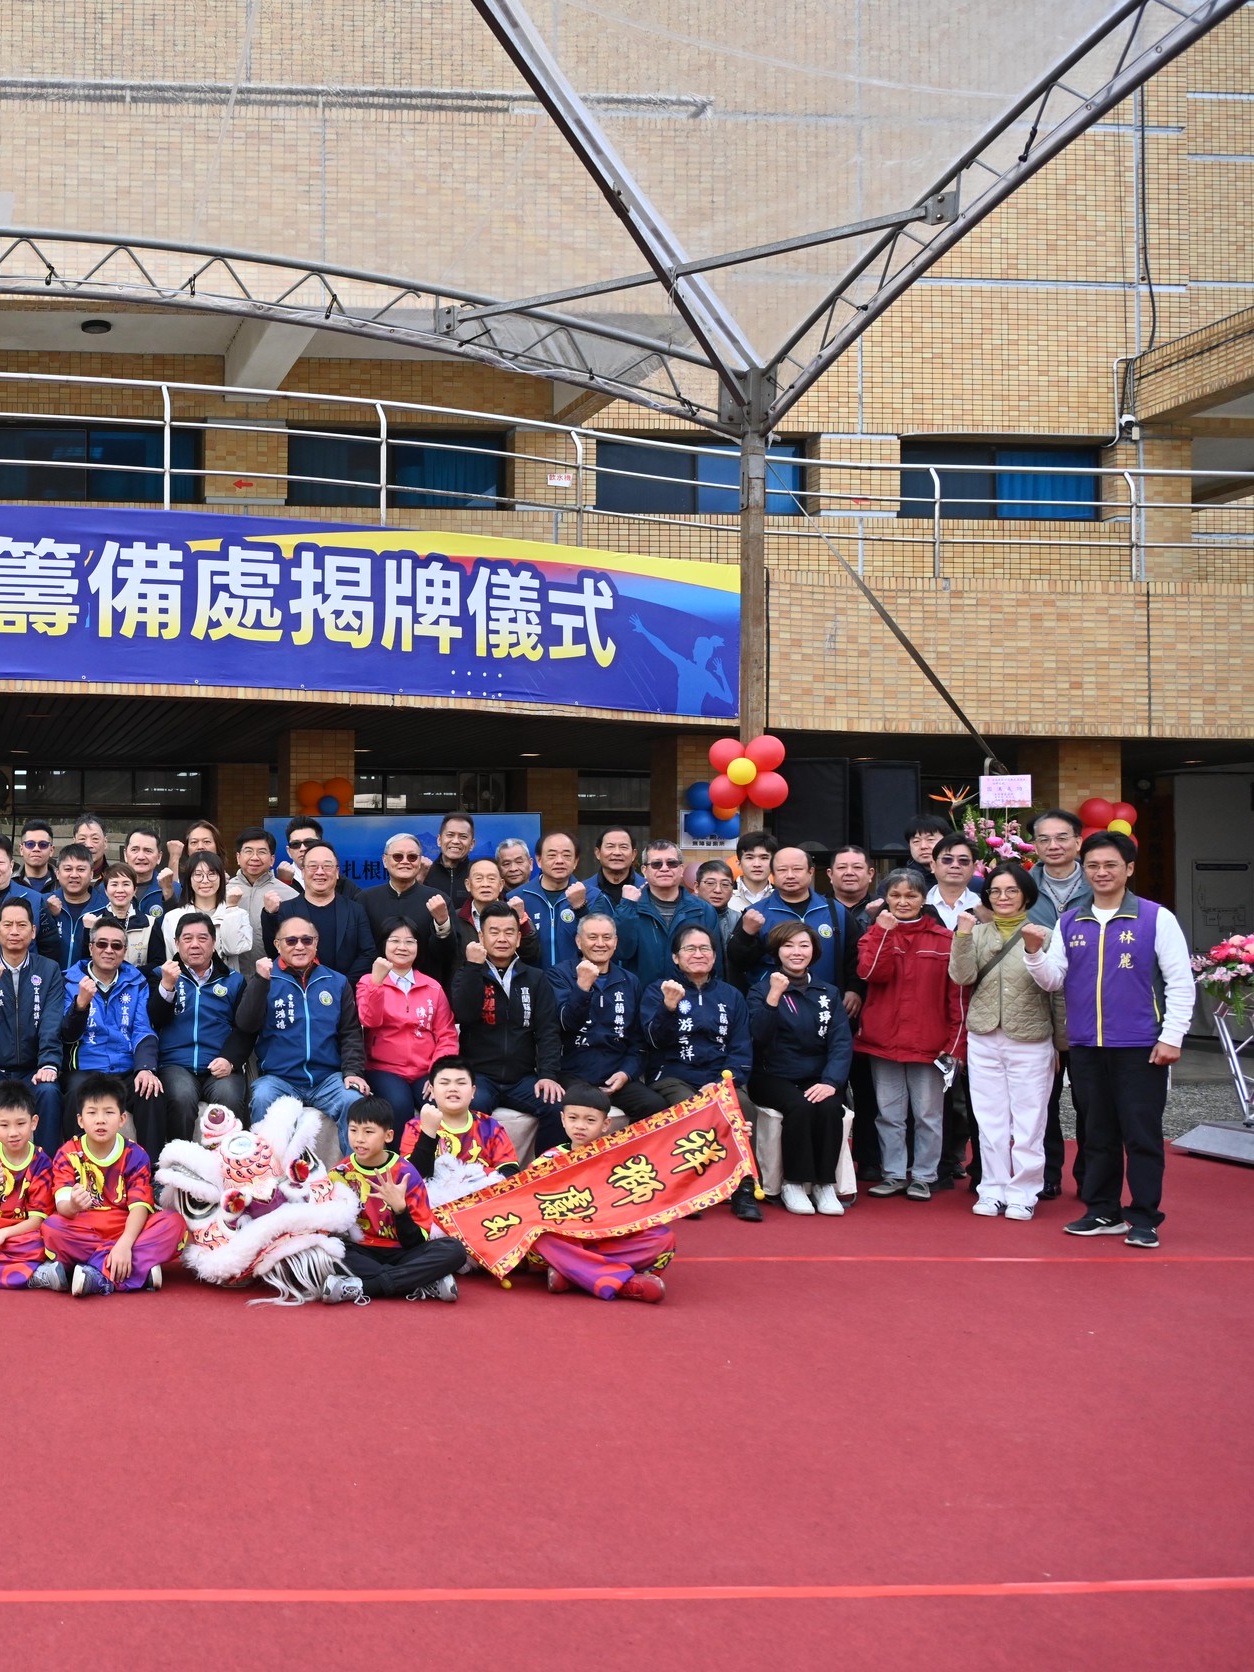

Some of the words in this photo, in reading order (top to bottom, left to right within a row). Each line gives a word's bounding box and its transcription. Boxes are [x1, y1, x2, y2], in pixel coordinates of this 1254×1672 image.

[548, 473, 573, 482] 飲水機
[343, 860, 392, 881] 扎根
